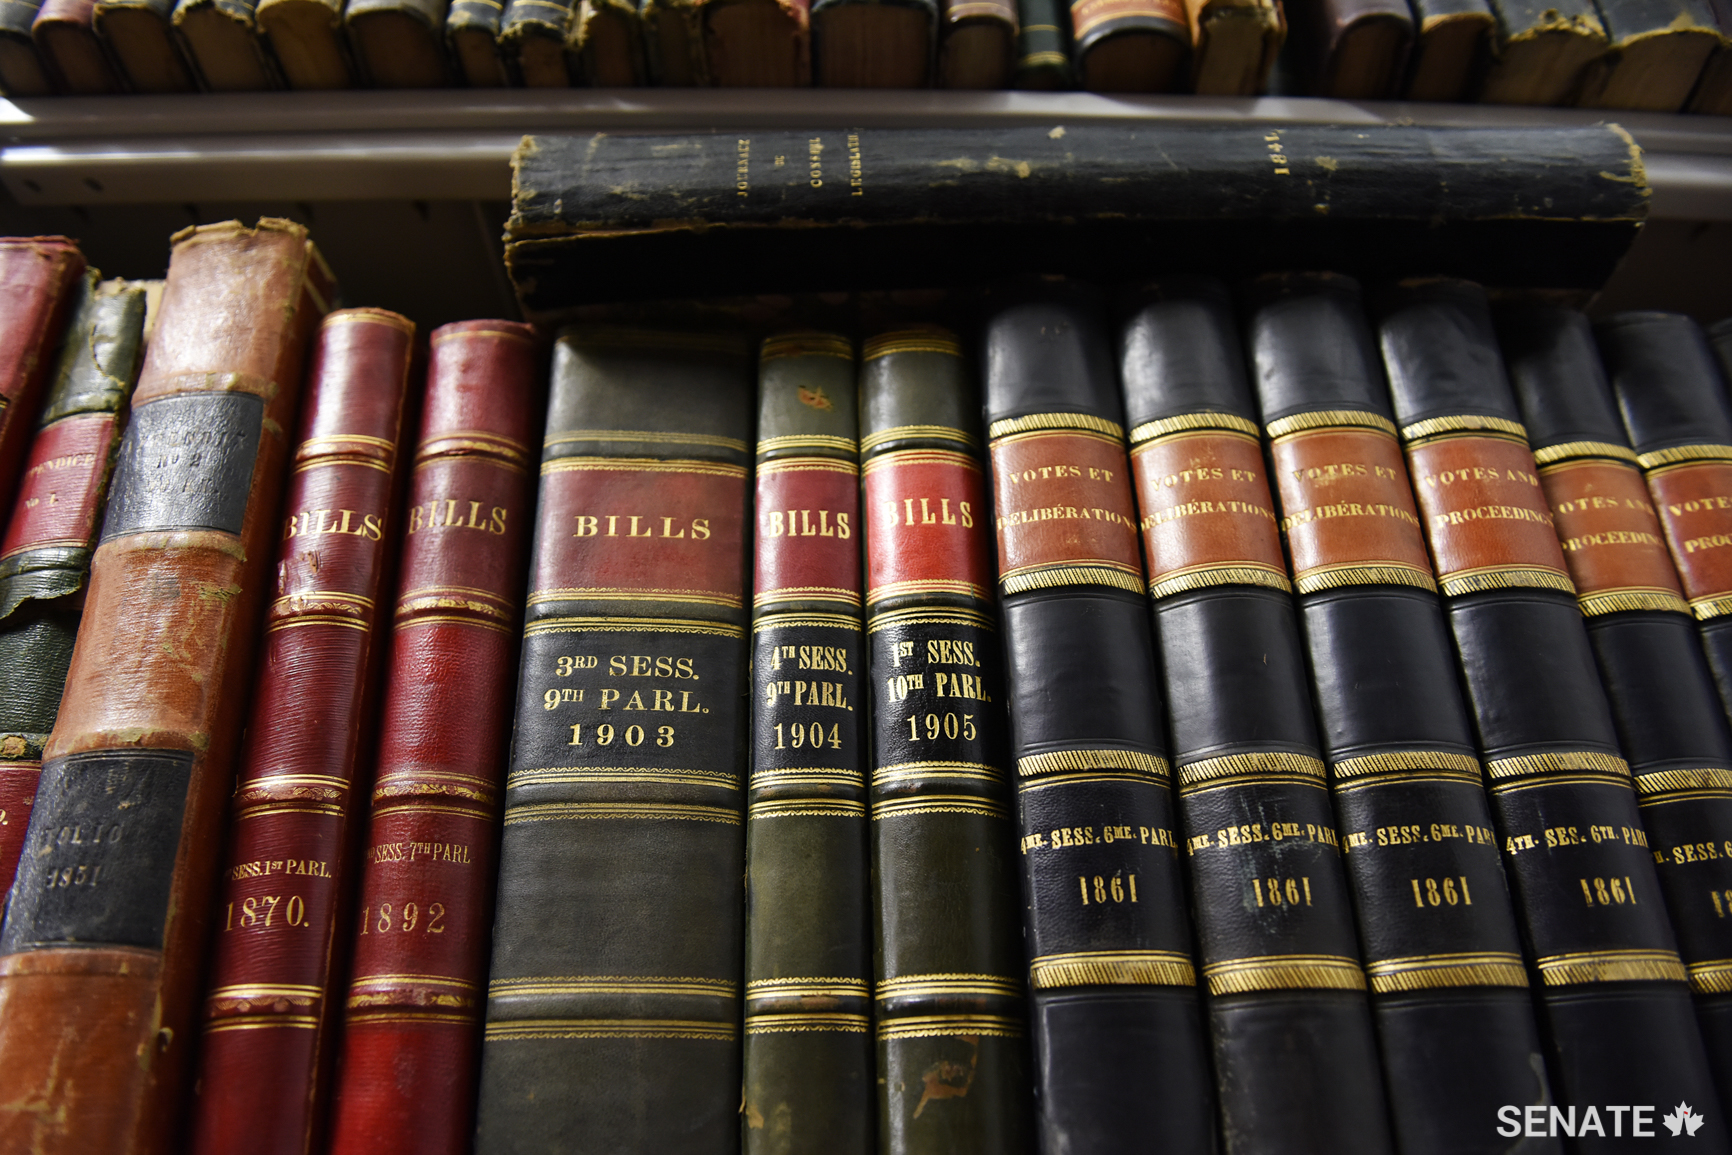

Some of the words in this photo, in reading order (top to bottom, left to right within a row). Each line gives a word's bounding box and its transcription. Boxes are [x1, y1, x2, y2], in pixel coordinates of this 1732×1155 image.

[1009, 465, 1081, 484] VOTES
[1088, 467, 1114, 482] ET
[1151, 467, 1224, 491] VOTES
[1231, 468, 1256, 482] ET
[1292, 463, 1368, 482] VOTES
[1374, 465, 1396, 480] ET
[1425, 467, 1499, 488] VOTES
[1507, 469, 1538, 487] AND
[408, 499, 507, 535] BILLS
[883, 497, 974, 530] BILLS
[1558, 496, 1619, 514] OTES
[1668, 496, 1732, 516] VOTE
[283, 508, 383, 541] BILLS
[573, 515, 711, 541] BILLS
[768, 509, 851, 540] BILLS
[770, 646, 796, 671] 4TH
[799, 647, 853, 676] SESS.
[892, 640, 914, 668] 1ST
[927, 639, 981, 668] SESS.
[556, 655, 598, 678] 3RD
[608, 656, 700, 680] SESS.
[543, 688, 585, 712] 9TH
[598, 689, 710, 714] PARL.
[766, 681, 791, 708] 9TH
[794, 681, 854, 712] PARL.
[886, 673, 925, 703] 10TH
[935, 672, 992, 702] PARL.
[567, 723, 675, 748] 1903
[773, 721, 843, 750] 1904
[906, 712, 977, 743] 1905
[1051, 826, 1100, 849] SESS.
[1218, 824, 1270, 849] SESS.
[1376, 824, 1428, 846] SESS.
[432, 842, 471, 864] PARL
[1672, 842, 1723, 865] SESS.
[285, 859, 332, 879] PARL.
[1078, 874, 1139, 906] 1861
[1252, 877, 1313, 907] 1861
[1411, 876, 1472, 908] 1861
[1580, 876, 1637, 907] 1861
[224, 894, 310, 933] 1870.
[360, 901, 446, 936] 1892
